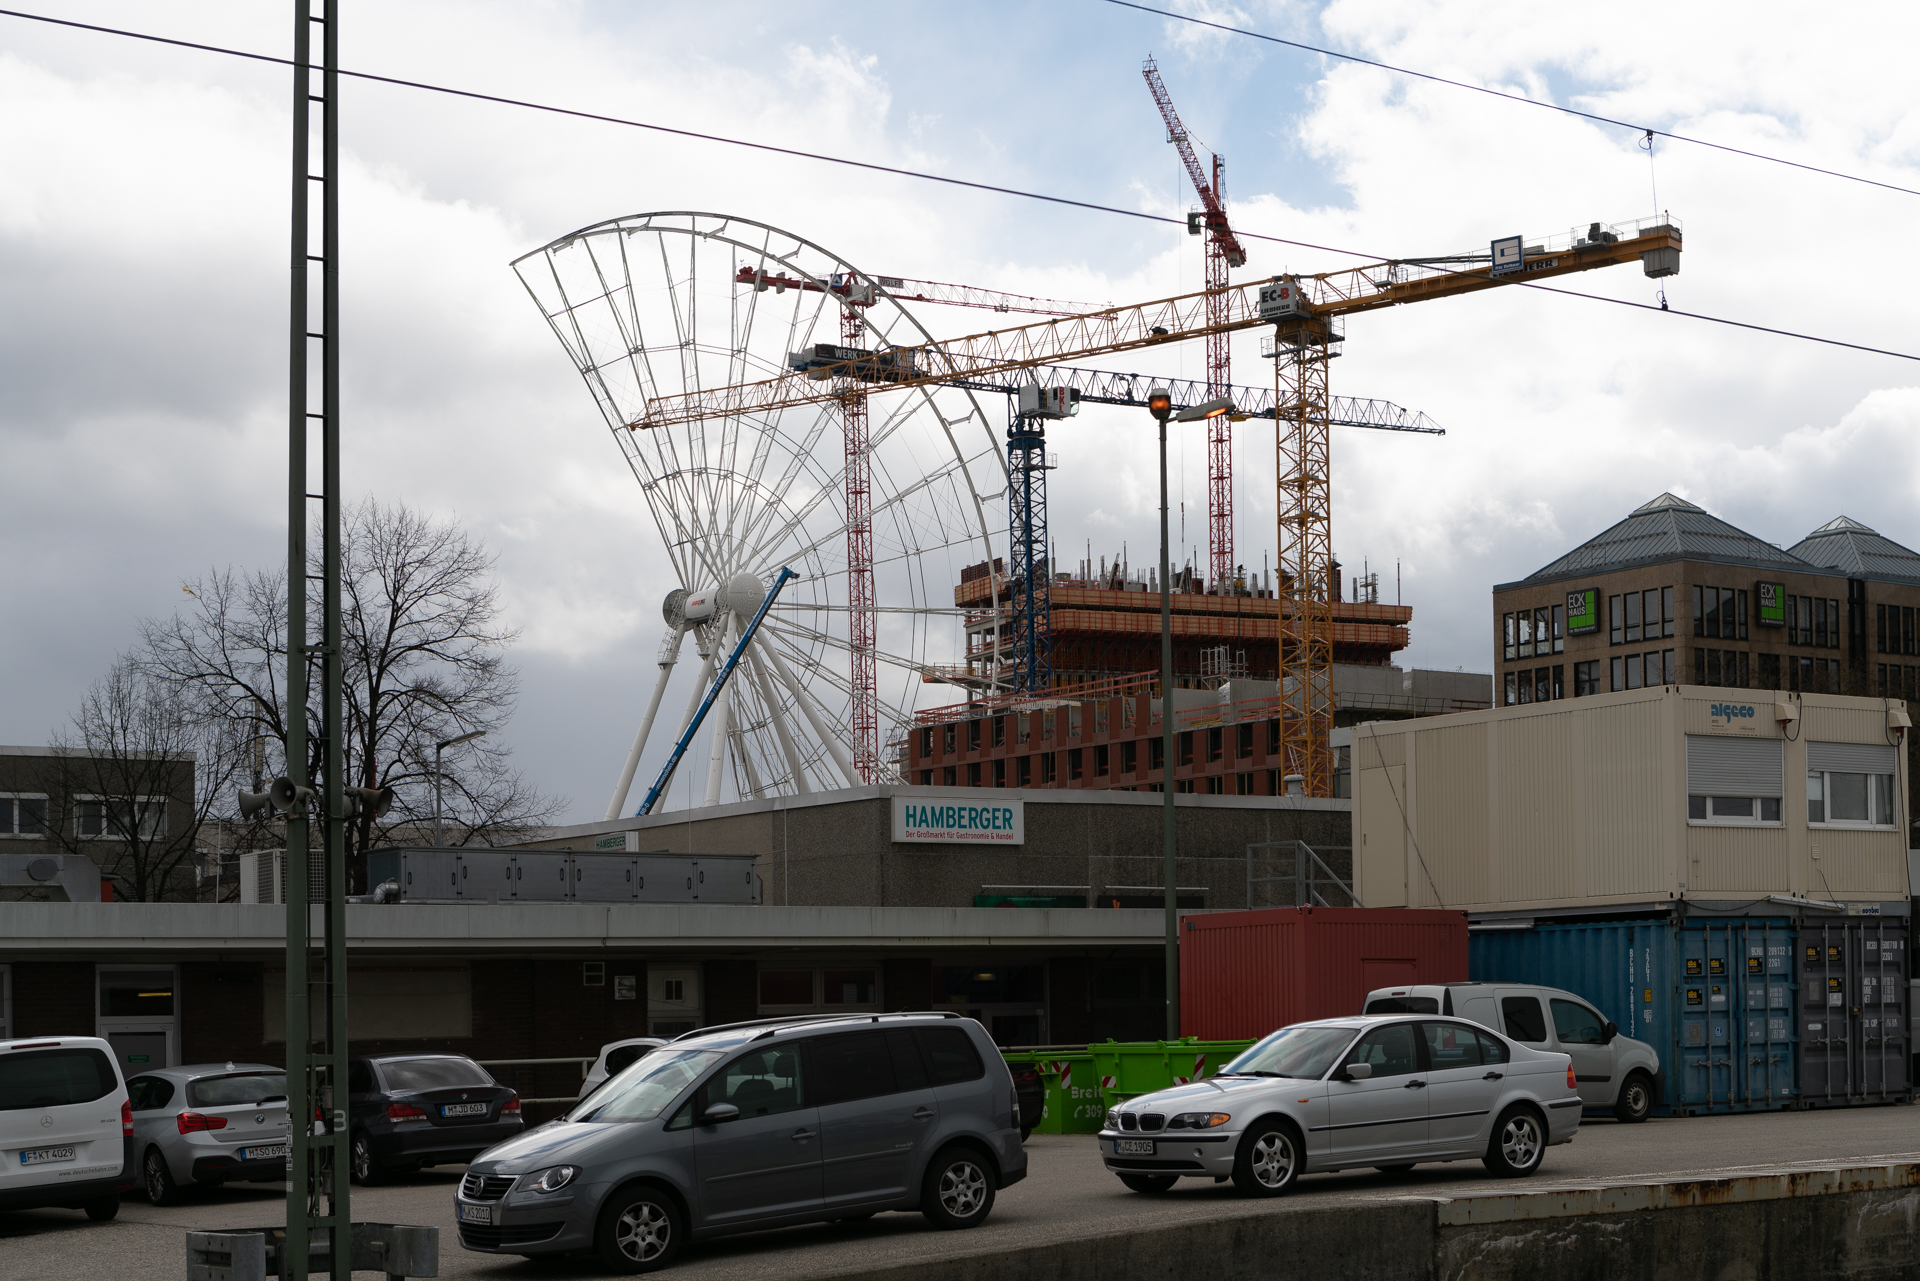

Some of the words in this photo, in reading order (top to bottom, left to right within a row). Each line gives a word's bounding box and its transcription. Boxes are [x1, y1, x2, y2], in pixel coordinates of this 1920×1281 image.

[1262, 287, 1290, 303] EC-B
[1261, 304, 1291, 314] LIEBHERR
[835, 348, 858, 360] WERK
[1761, 584, 1776, 598] ECK
[1568, 593, 1585, 608] ECK
[1761, 598, 1776, 607] HAUS
[1569, 607, 1586, 617] HAUS
[1711, 703, 1754, 723] algeco
[906, 805, 1014, 830] HAMBERGER
[906, 830, 915, 838] Der
[917, 830, 946, 839] Großmarkt
[947, 831, 955, 839] für
[957, 831, 990, 840] Gastronomie
[991, 832, 995, 840] &
[996, 832, 1014, 840] Handel
[596, 836, 626, 850] HAMBERGER
[1751, 946, 1763, 956] BCHU
[1768, 958, 1780, 967] 22G1
[459, 1105, 468, 1113] JD
[470, 1104, 483, 1113] 603
[1085, 1104, 1102, 1118] 309
[260, 1148, 270, 1156] SO
[271, 1146, 286, 1155] 690
[1125, 1142, 1133, 1151] CE
[1134, 1142, 1152, 1152] 1905
[39, 1151, 49, 1160] KT
[52, 1148, 73, 1158] 4029
[58, 1165, 118, 1177] www.deutschebahn.com
[476, 1207, 489, 1220] 2010
